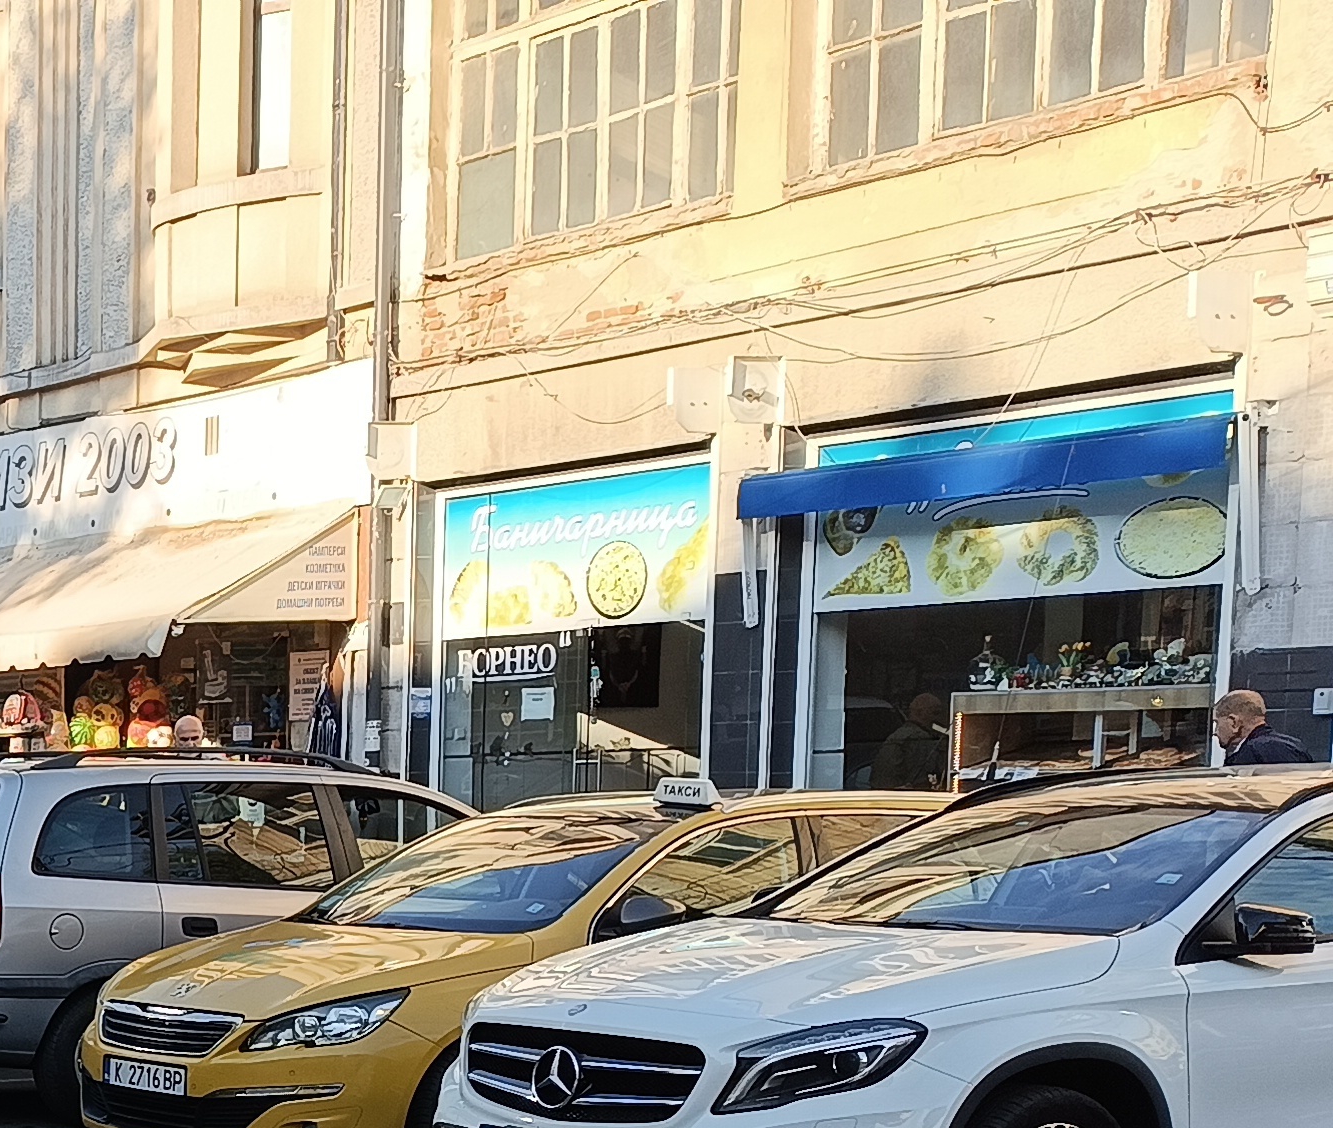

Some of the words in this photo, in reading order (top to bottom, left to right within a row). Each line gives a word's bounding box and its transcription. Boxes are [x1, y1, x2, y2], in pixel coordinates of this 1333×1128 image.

[75, 417, 177, 498] 2003
[470, 500, 698, 557] Баничарница
[308, 546, 346, 557] ПАМПЕРСИ
[287, 581, 314, 593] ДЕТСКИ
[276, 598, 313, 610] ДОМАШНИ
[314, 597, 345, 608] ПОТРЕБИ
[663, 784, 701, 798] ТАКСИ
[114, 1061, 123, 1084] K
